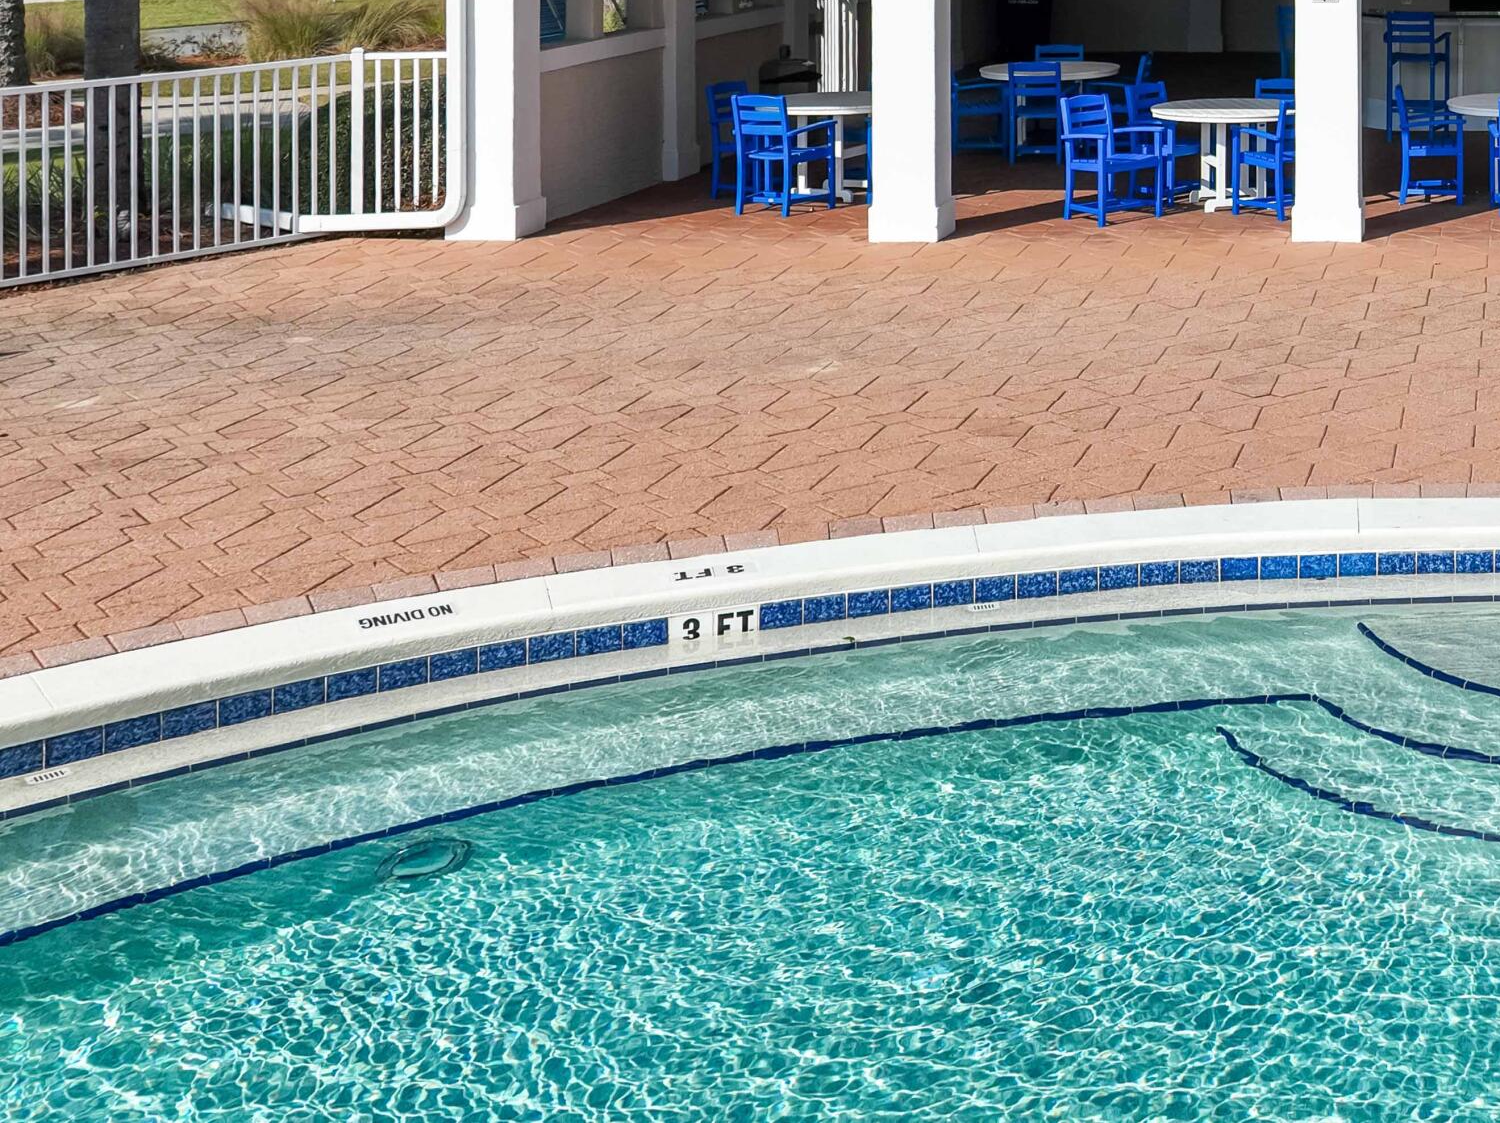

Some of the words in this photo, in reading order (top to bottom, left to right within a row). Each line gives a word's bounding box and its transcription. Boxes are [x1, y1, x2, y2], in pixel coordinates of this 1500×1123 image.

[726, 564, 745, 574] 3
[427, 604, 454, 617] NO
[358, 609, 426, 629] DIVING
[682, 617, 701, 641] 3
